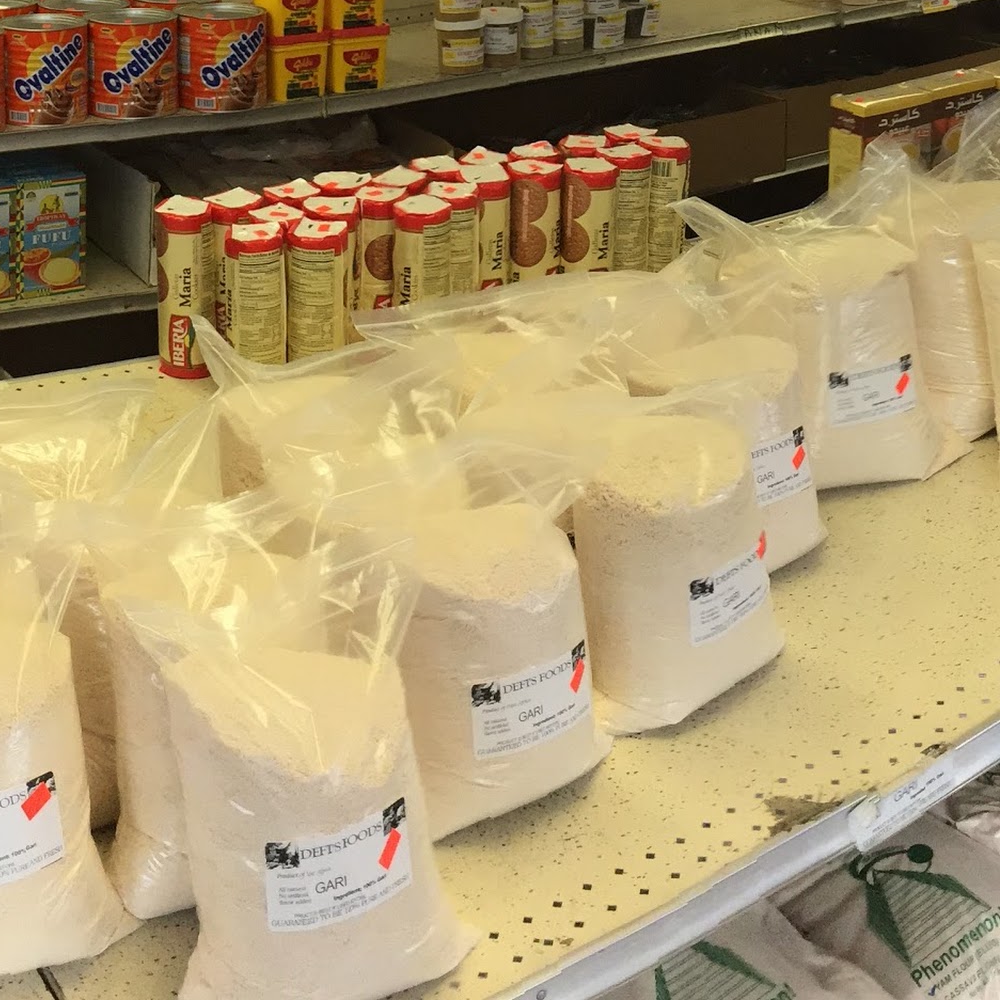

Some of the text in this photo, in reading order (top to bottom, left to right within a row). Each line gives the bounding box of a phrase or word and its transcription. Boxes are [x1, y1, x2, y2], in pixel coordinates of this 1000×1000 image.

[13, 33, 83, 100] Ovaltine
[103, 26, 174, 94] Ovaltine
[200, 21, 266, 90] Ovaltine
[878, 107, 920, 127] كاسترد
[32, 231, 71, 245] FUFU
[492, 230, 504, 271] Maria
[553, 219, 561, 258] Maria
[598, 221, 609, 261] Maria
[179, 267, 191, 307] Maria
[400, 266, 412, 306] Maria
[172, 318, 188, 367] IBERIA
[751, 447, 769, 459] EFTS
[757, 471, 775, 483] GARI
[540, 661, 572, 682] FOODS
[518, 705, 544, 722] GARI
[342, 821, 383, 848] FOODS
[315, 875, 348, 894] GARI
[937, 974, 952, 989] YAM
